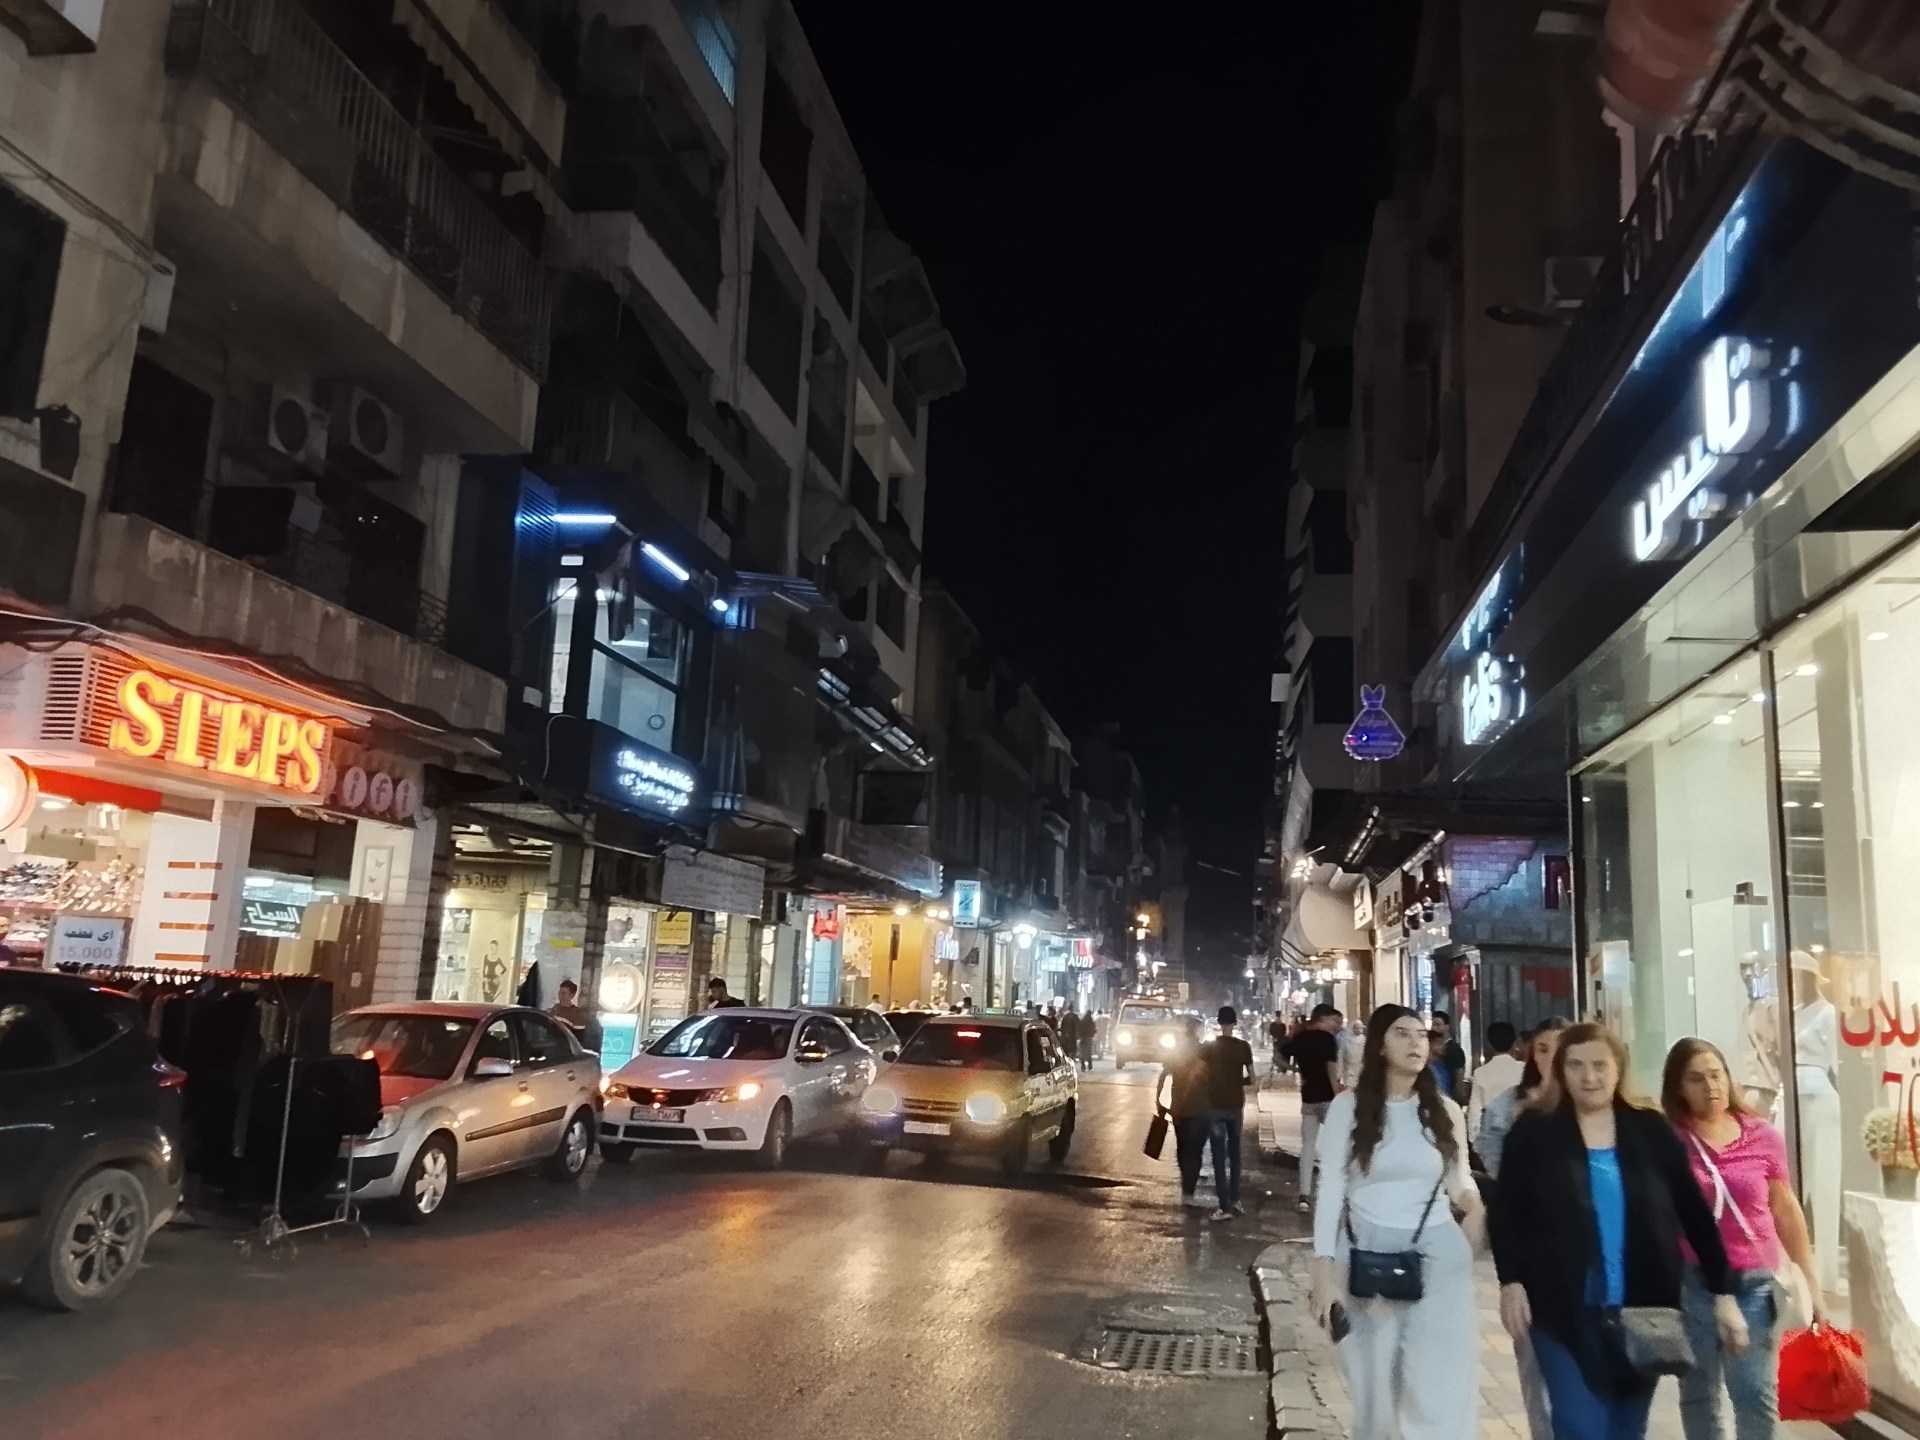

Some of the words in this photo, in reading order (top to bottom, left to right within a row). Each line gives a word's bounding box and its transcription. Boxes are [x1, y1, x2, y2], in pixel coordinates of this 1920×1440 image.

[109, 670, 325, 793] STEPS
[245, 902, 301, 926] السماح
[60, 946, 113, 959] 15.000
